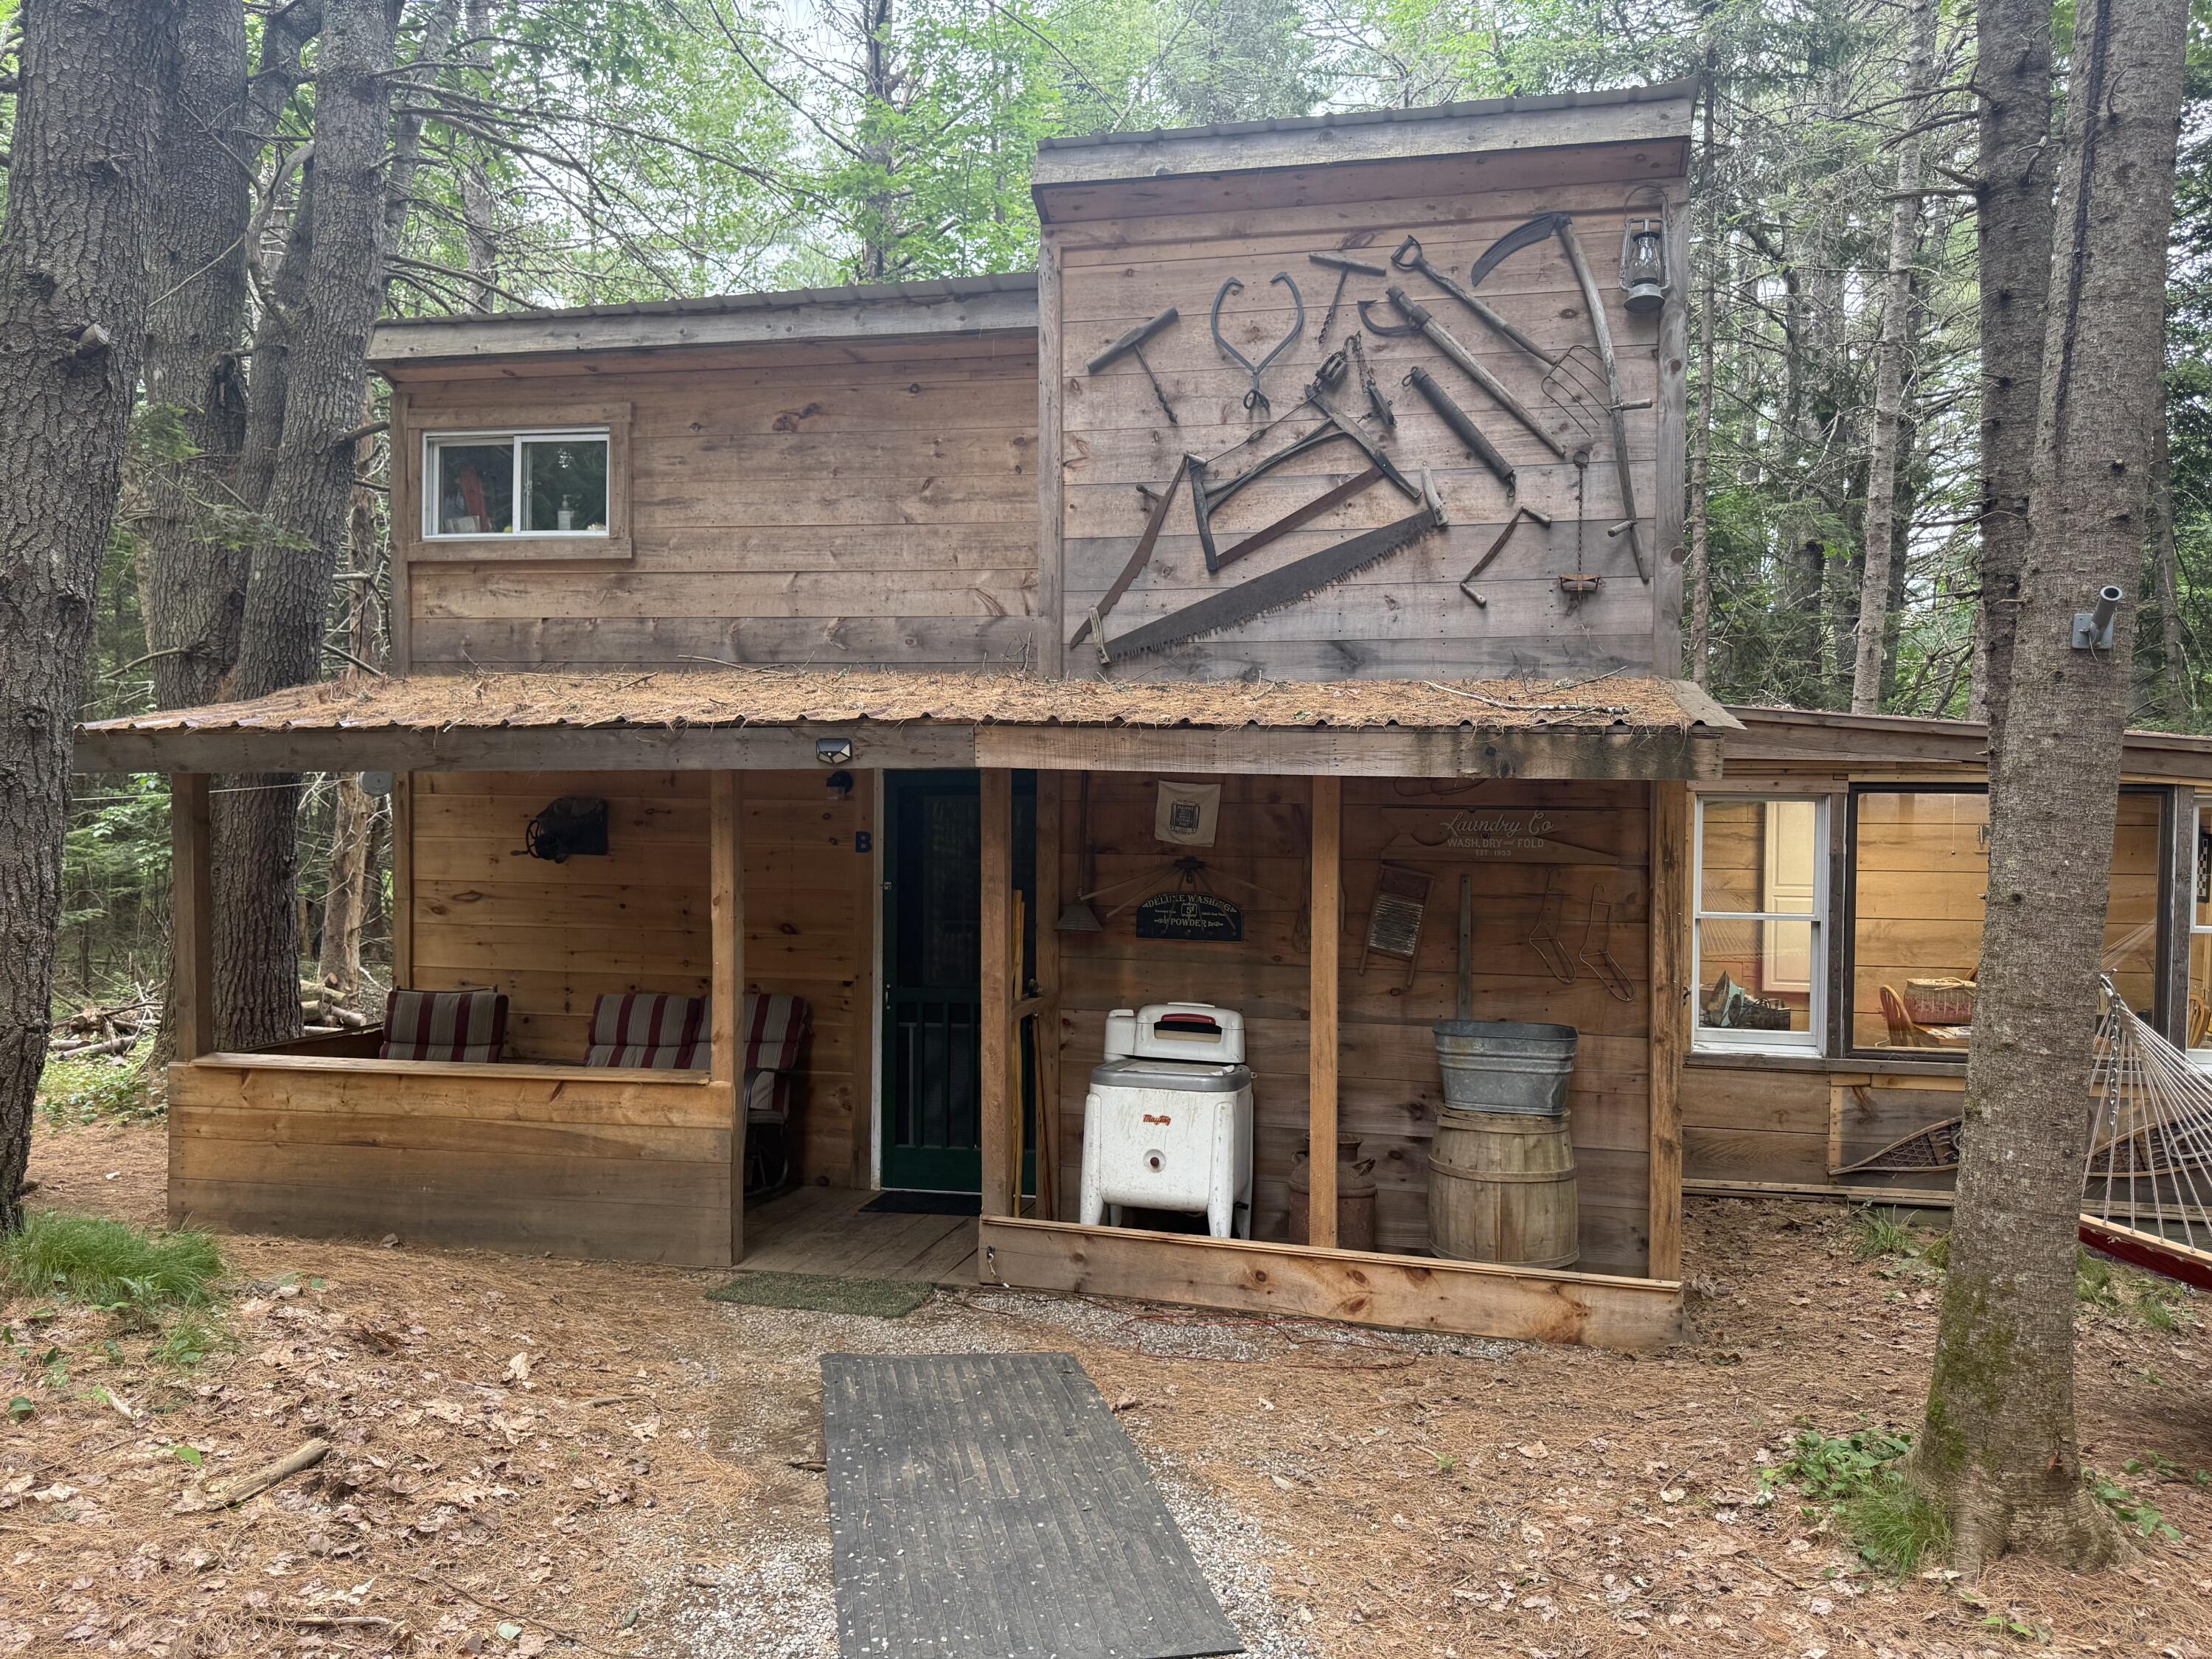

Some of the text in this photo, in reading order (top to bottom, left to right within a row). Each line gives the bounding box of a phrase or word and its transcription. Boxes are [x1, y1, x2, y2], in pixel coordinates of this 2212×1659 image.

[1440, 810, 1554, 837] Laundry Co
[855, 831, 872, 852] B
[1482, 838, 1502, 849] DRY
[1517, 838, 1544, 849] FOLD
[1171, 918, 1207, 928] POWDER
[1143, 1114, 1171, 1126] Maytag
